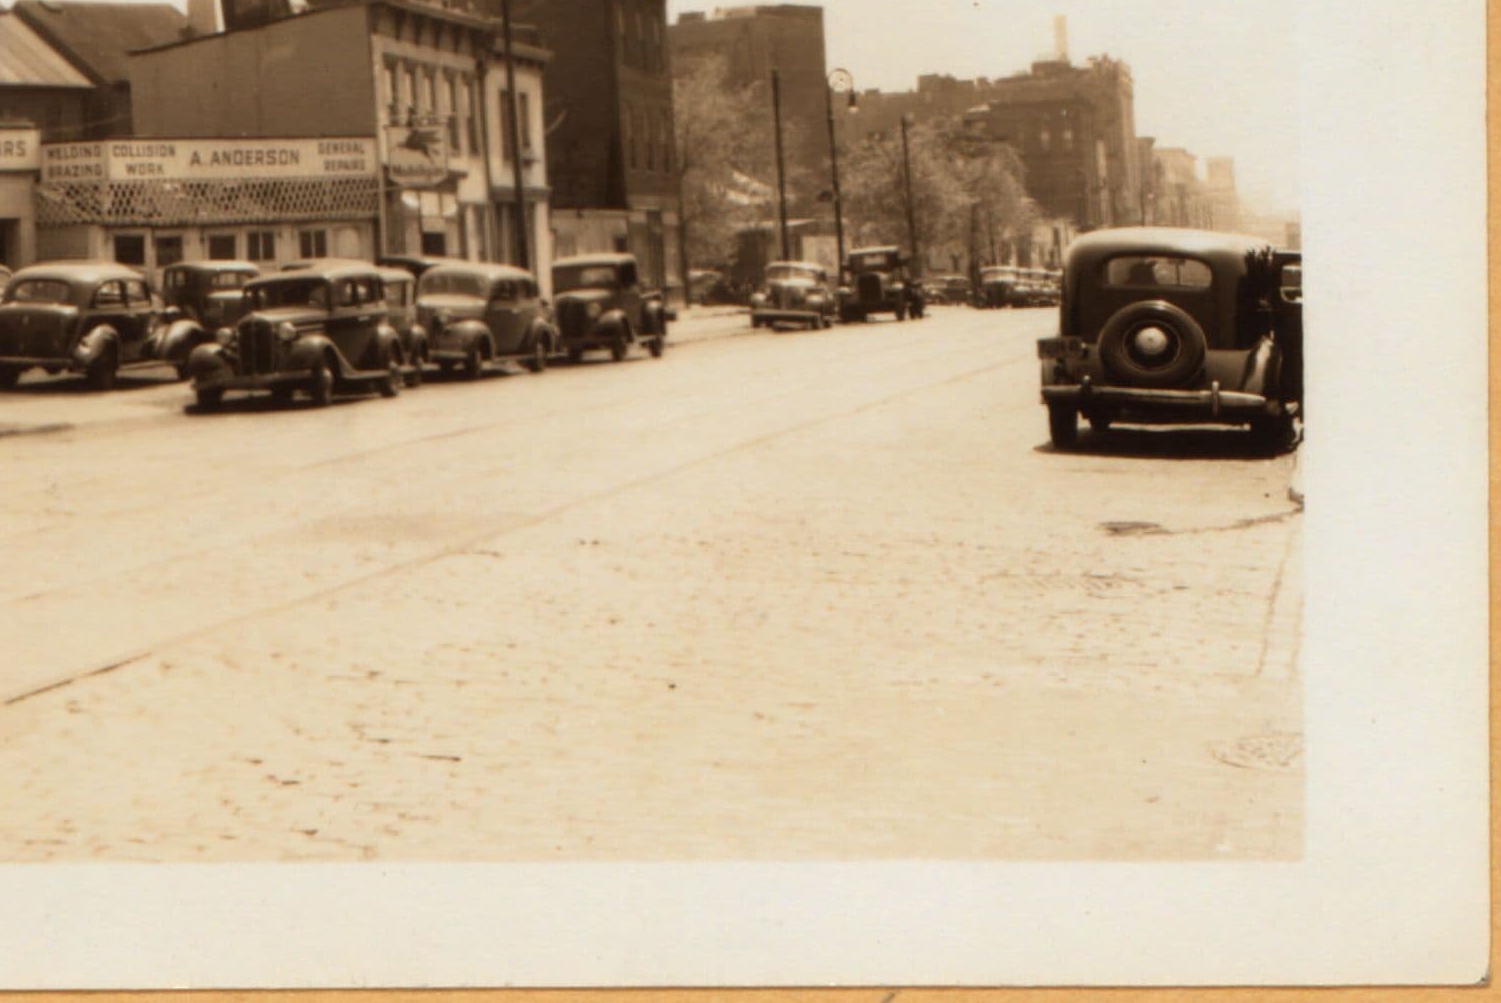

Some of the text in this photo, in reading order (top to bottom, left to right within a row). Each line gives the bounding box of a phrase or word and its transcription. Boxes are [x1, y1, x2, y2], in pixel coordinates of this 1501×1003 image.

[46, 144, 102, 161] WELDING
[111, 144, 177, 158] COLLISION
[317, 141, 366, 156] GENERAL
[210, 148, 301, 167] ANDERSON
[323, 158, 366, 172] REPAIRS
[47, 163, 103, 179] BRAZING
[125, 162, 166, 176] WORK
